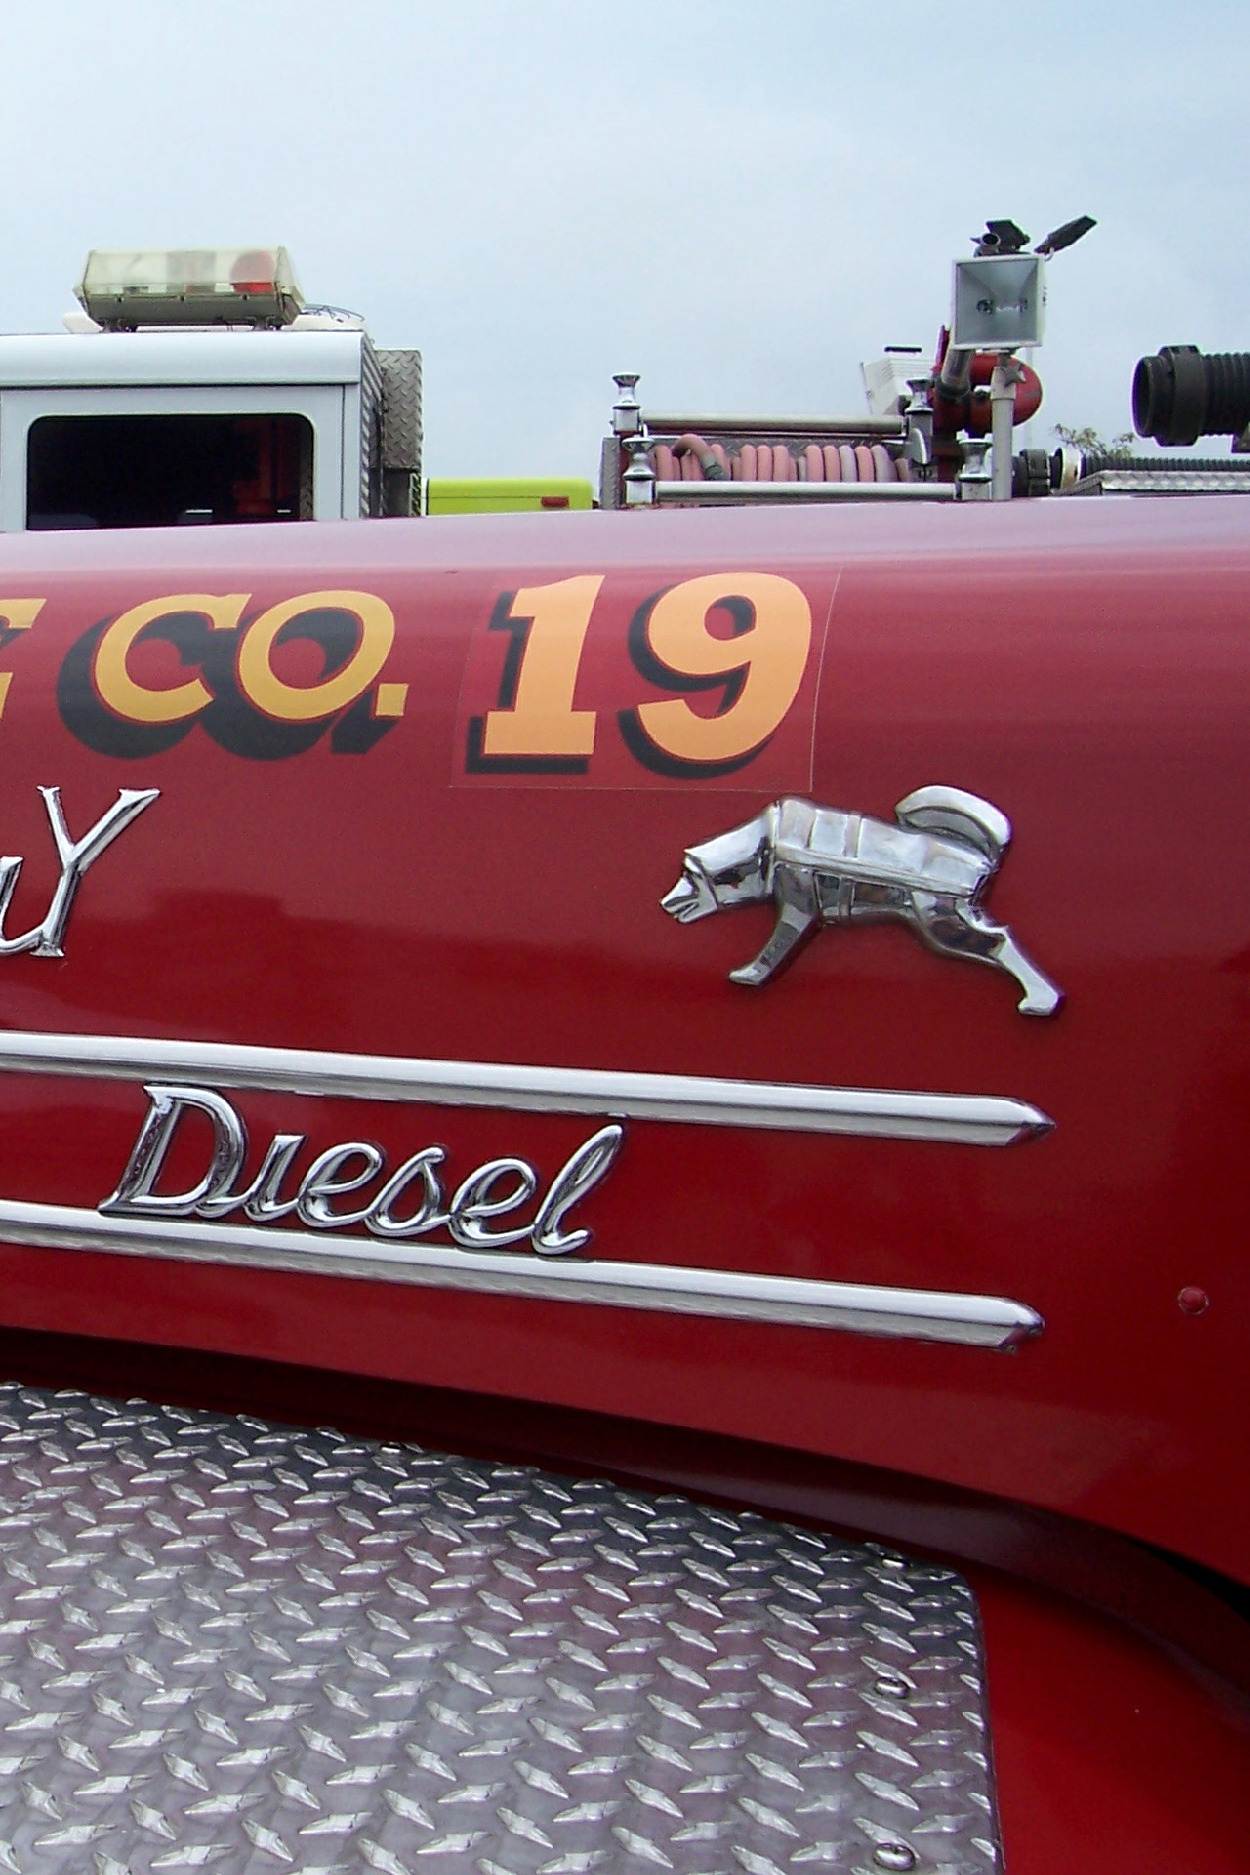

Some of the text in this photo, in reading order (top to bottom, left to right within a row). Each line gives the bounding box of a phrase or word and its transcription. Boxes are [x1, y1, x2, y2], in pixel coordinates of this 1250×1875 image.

[94, 589, 409, 725] CO.
[483, 571, 814, 762] 19
[97, 1082, 626, 1256] Diesel
